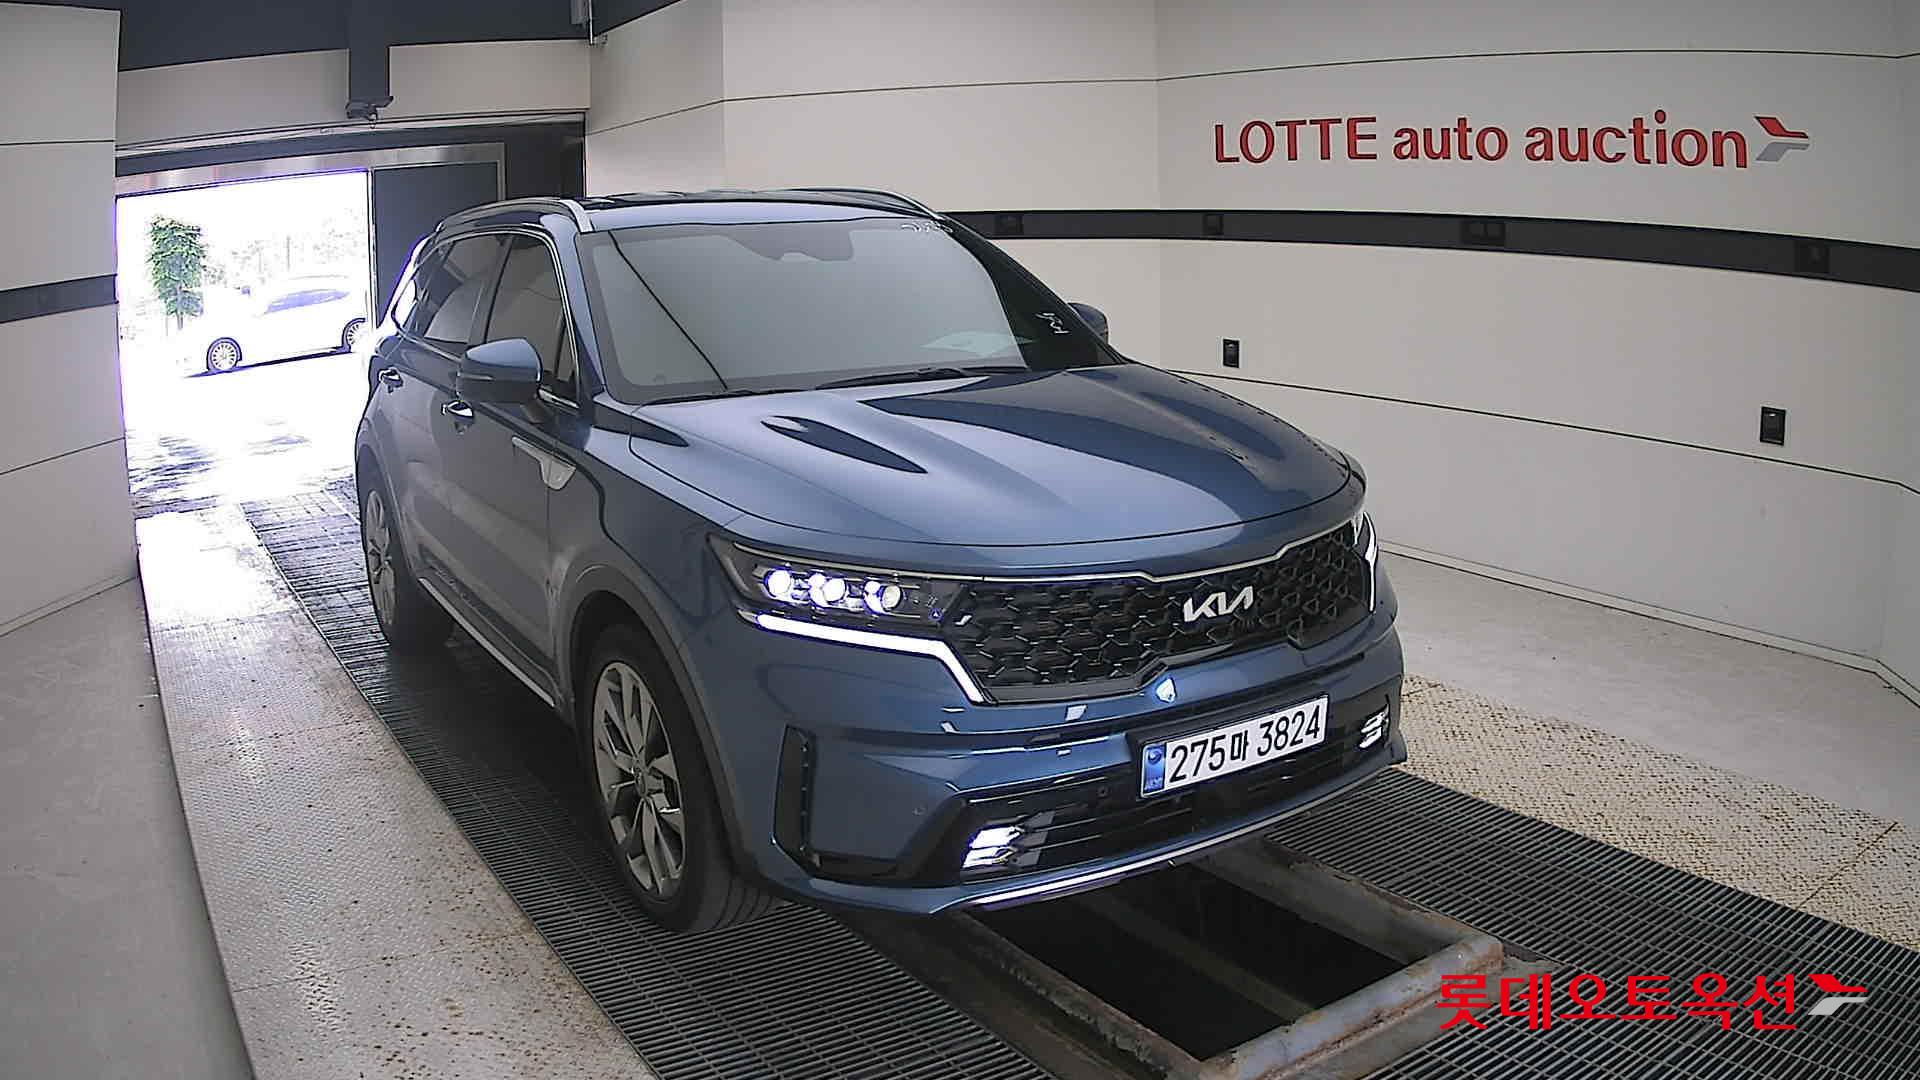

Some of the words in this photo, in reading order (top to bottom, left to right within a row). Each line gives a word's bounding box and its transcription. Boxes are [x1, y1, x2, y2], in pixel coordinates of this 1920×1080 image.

[1214, 116, 1378, 163] LOTTE
[1393, 116, 1509, 162] auto
[1524, 109, 1748, 169] auction
[1183, 585, 1254, 623] KIA
[1169, 729, 1249, 784] 275마
[1257, 704, 1321, 758] 3824
